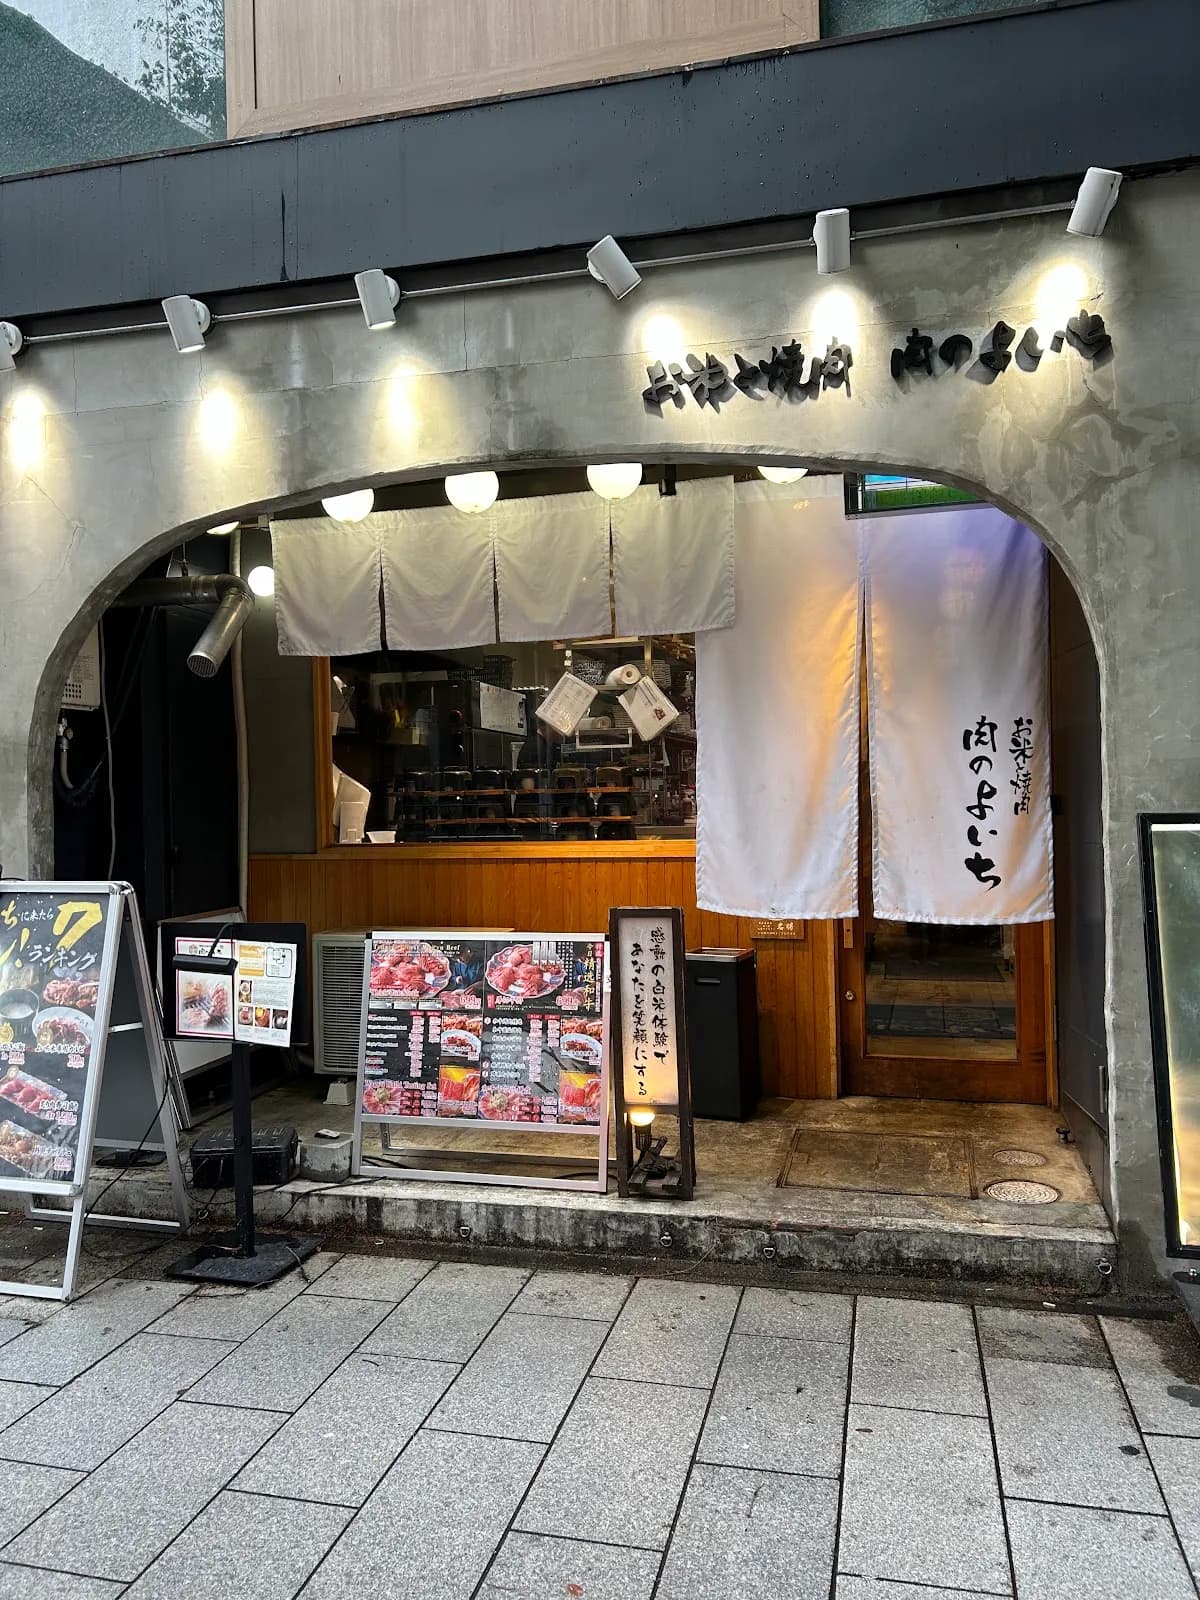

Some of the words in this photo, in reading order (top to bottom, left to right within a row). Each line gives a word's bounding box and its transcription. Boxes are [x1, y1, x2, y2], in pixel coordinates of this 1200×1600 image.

[642, 336, 853, 414] お米と焼肉
[891, 309, 1114, 386] 肉のよいち
[962, 715, 1002, 893] 肉のよいち
[1009, 716, 1034, 816] お米と焼肉
[28, 943, 98, 971] ランキング
[649, 926, 669, 1066] 感動の白米体験で
[630, 942, 649, 1097] あなたを笑顔にする
